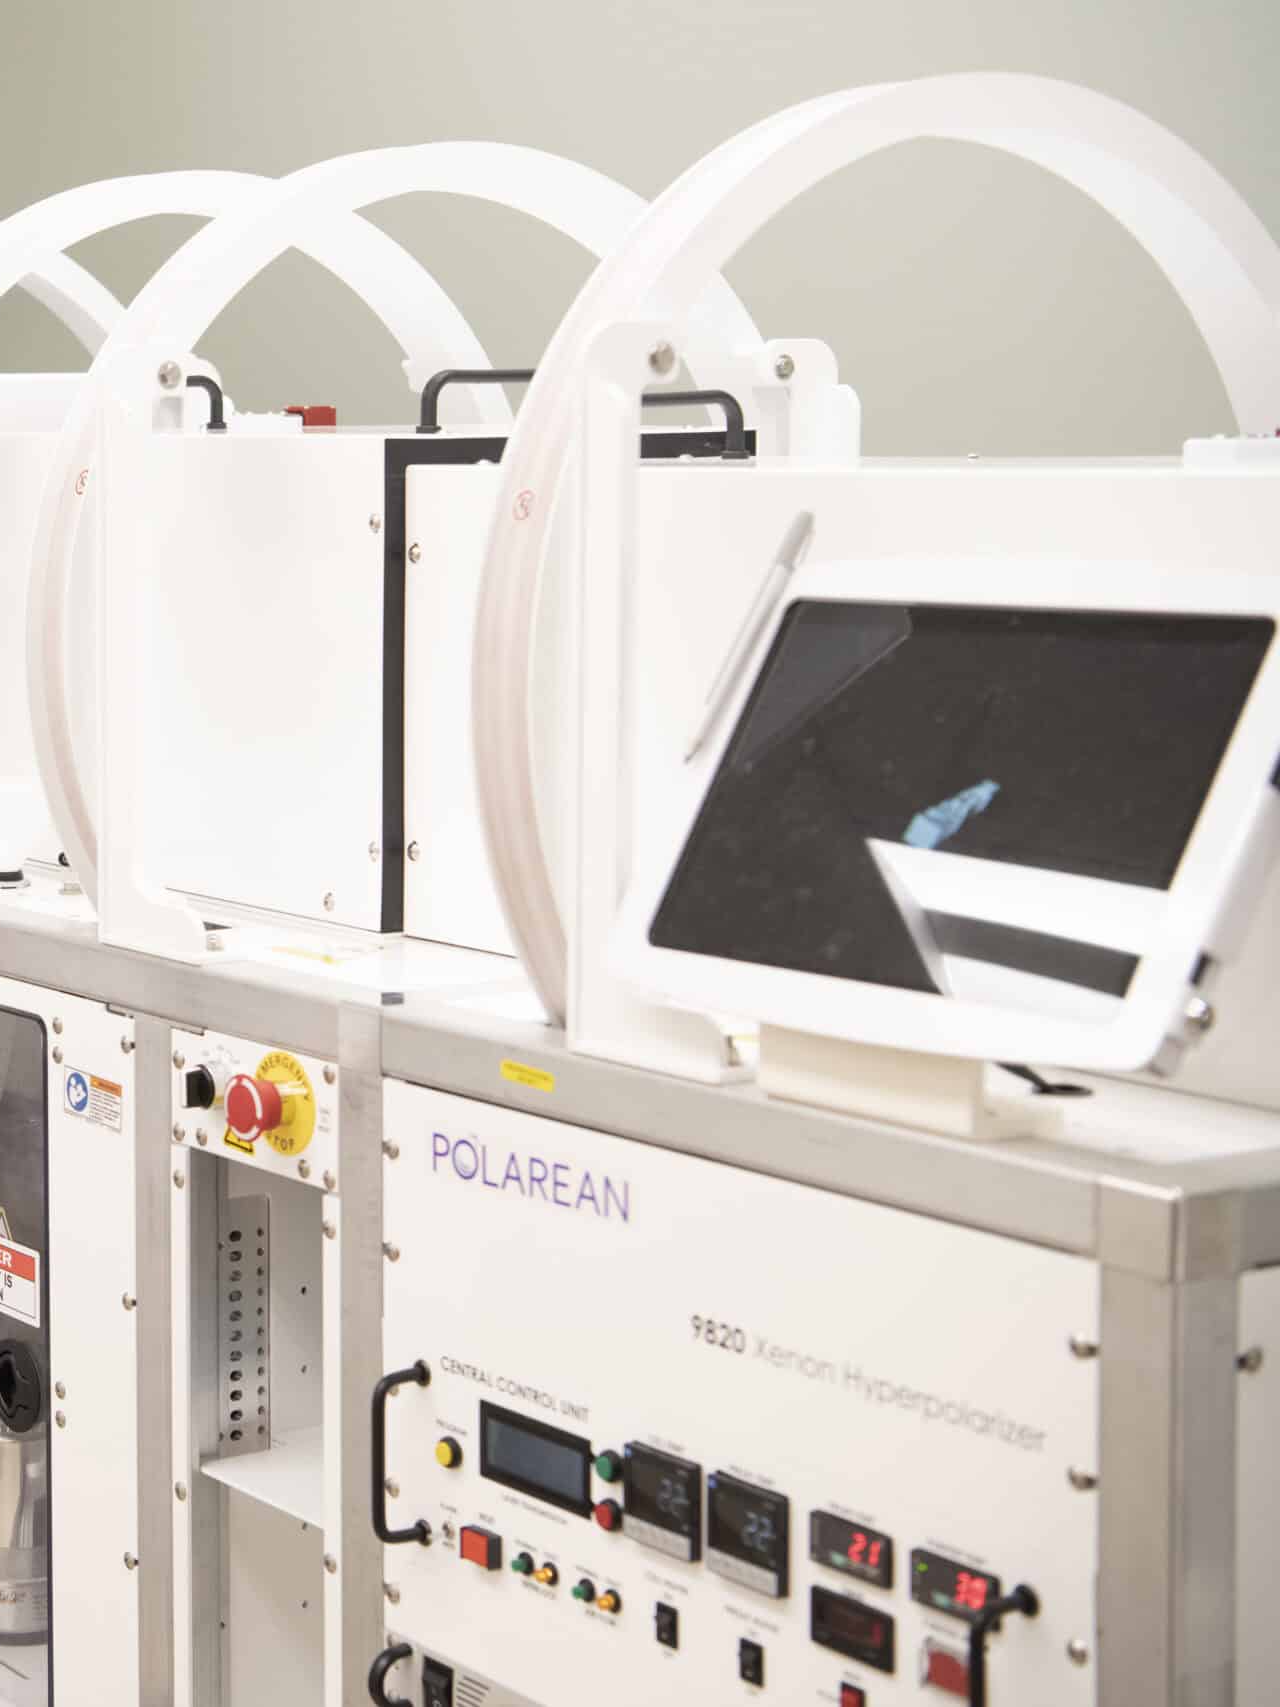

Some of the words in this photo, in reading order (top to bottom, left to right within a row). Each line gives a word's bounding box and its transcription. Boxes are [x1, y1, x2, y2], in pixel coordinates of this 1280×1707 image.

[265, 1132, 295, 1152] TOP
[432, 1132, 630, 1222] POLAREAN
[4, 1272, 13, 1288] IS
[440, 1355, 493, 1388] CENTRAL
[496, 1375, 558, 1412] CONTROL
[560, 1401, 589, 1423] UNIT
[690, 1314, 746, 1353] 9820
[752, 1337, 835, 1383] Xenon
[843, 1362, 1047, 1452] Hyperpolarizer
[847, 1532, 881, 1568] 21
